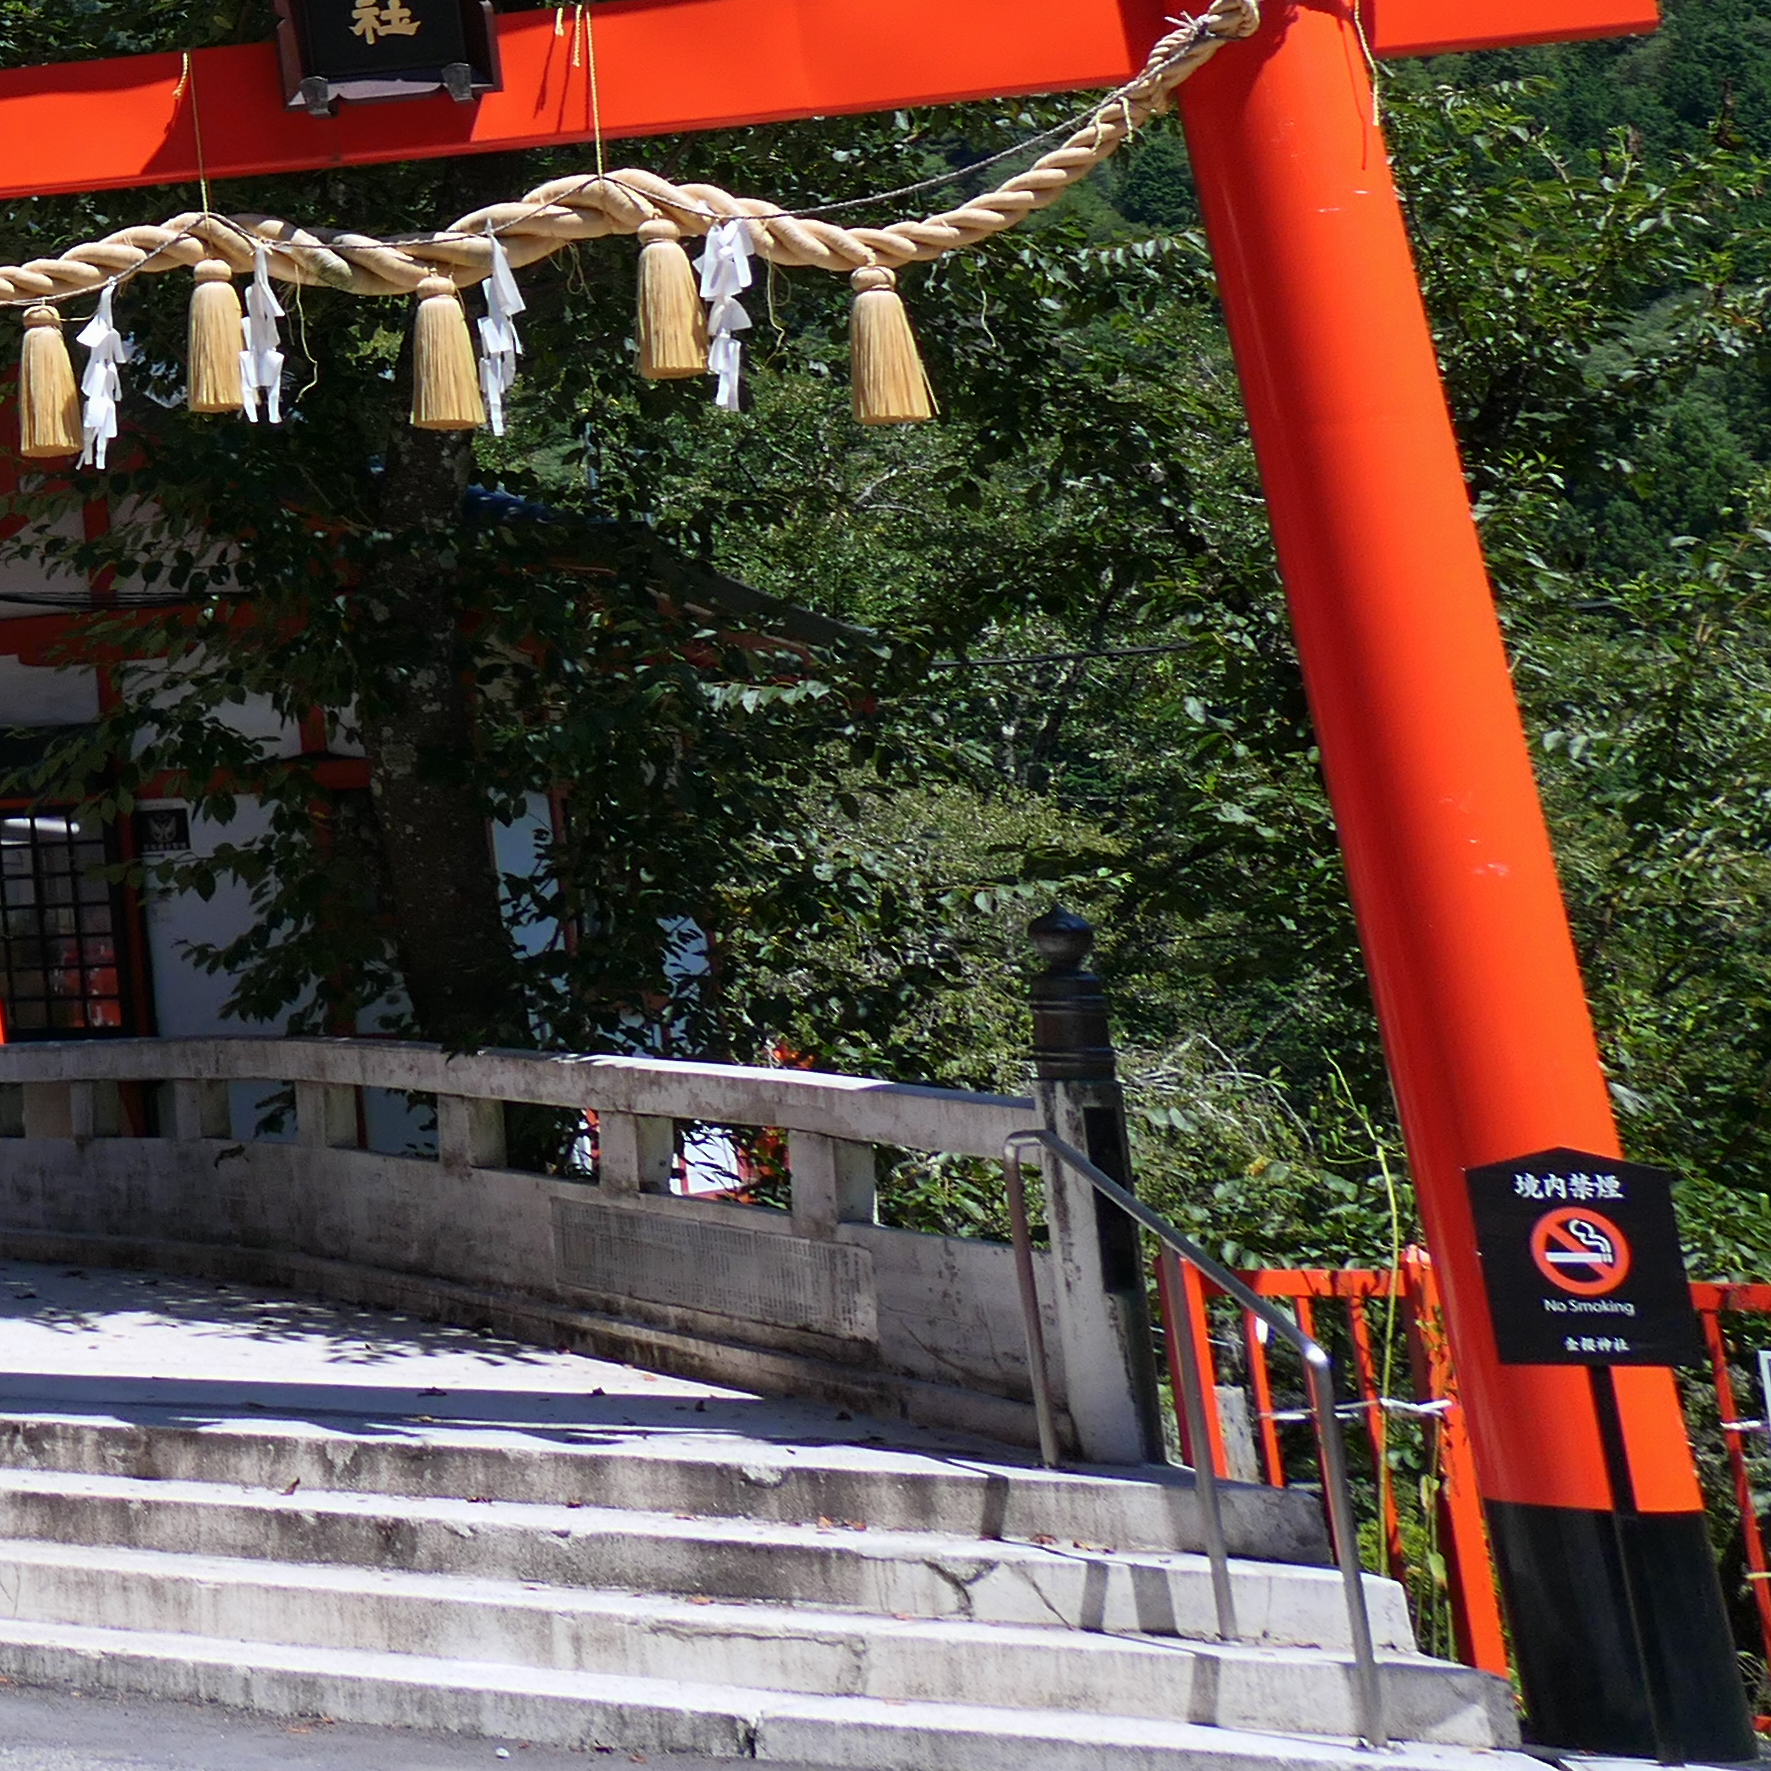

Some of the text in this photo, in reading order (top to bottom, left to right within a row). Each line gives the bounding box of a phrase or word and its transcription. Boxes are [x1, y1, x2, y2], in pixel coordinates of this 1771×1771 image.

[1513, 1172, 1626, 1200] 境内禁煙
[1543, 1298, 1636, 1317] No Smoking
